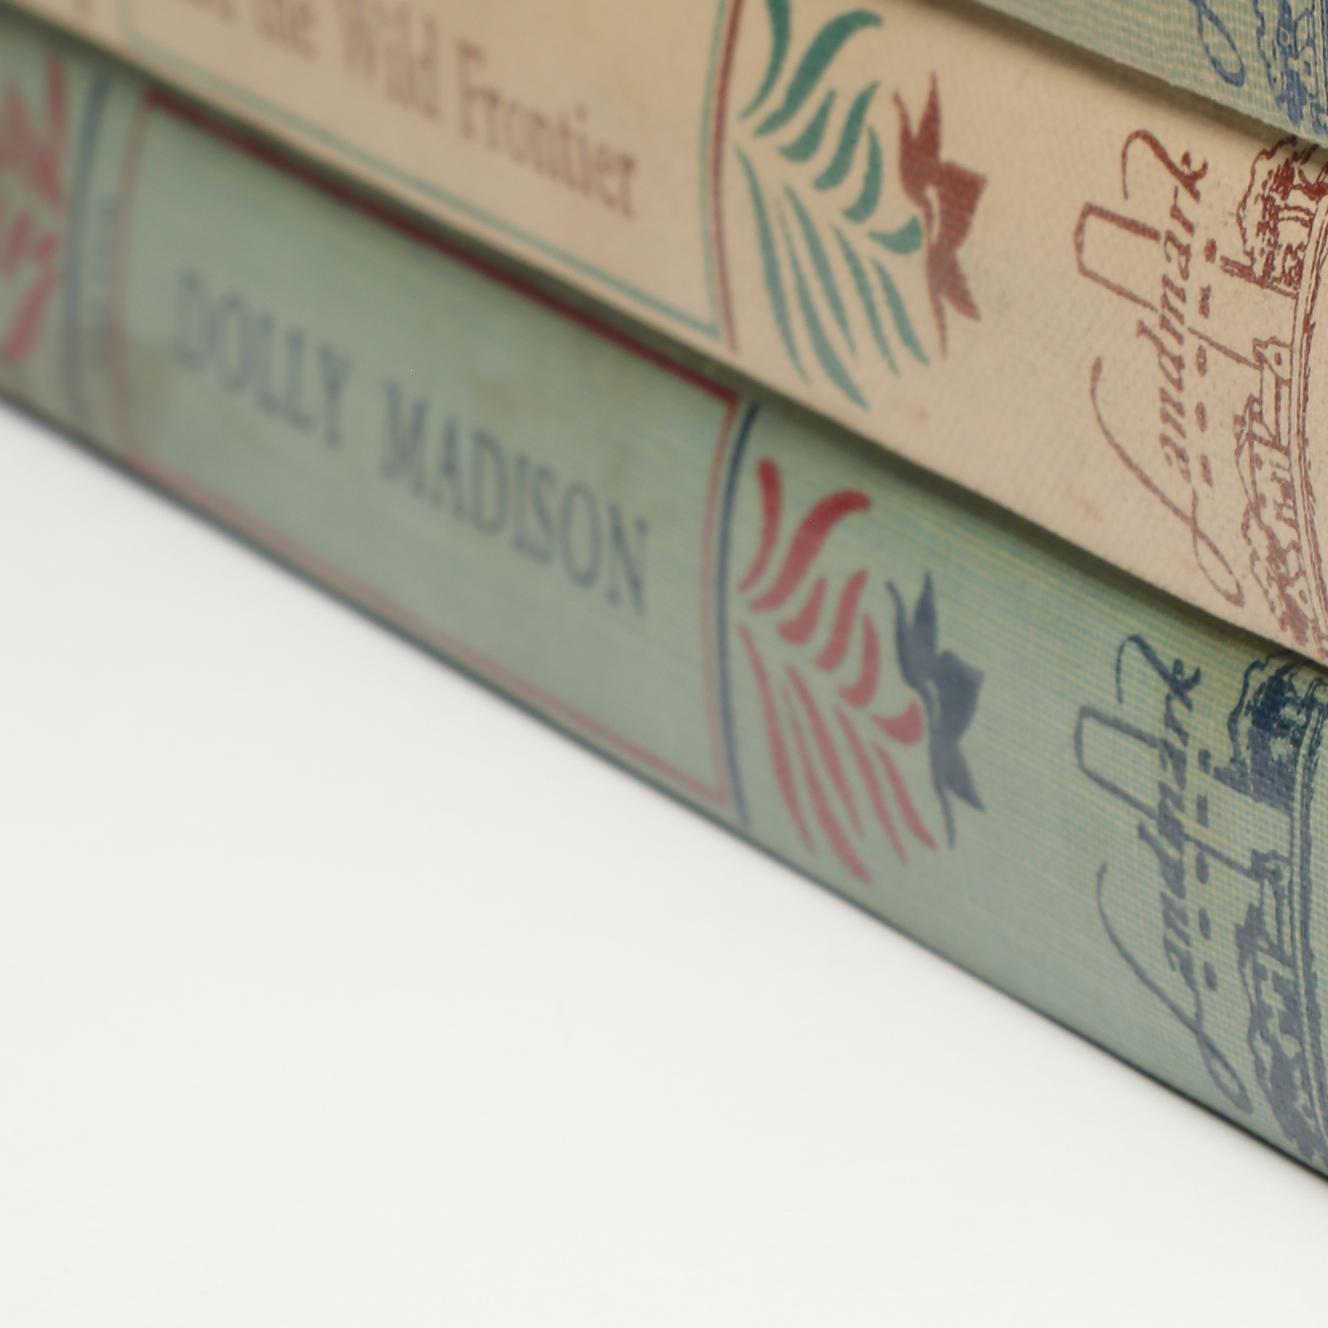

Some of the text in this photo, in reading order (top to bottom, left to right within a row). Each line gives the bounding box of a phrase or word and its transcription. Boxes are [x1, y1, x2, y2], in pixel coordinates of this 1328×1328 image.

[455, 38, 639, 220] Frontier
[174, 266, 353, 450] DOLLY
[380, 378, 650, 618] MADISON
[1091, 129, 1246, 606] Landmark
[1096, 634, 1253, 1114] Landmark
